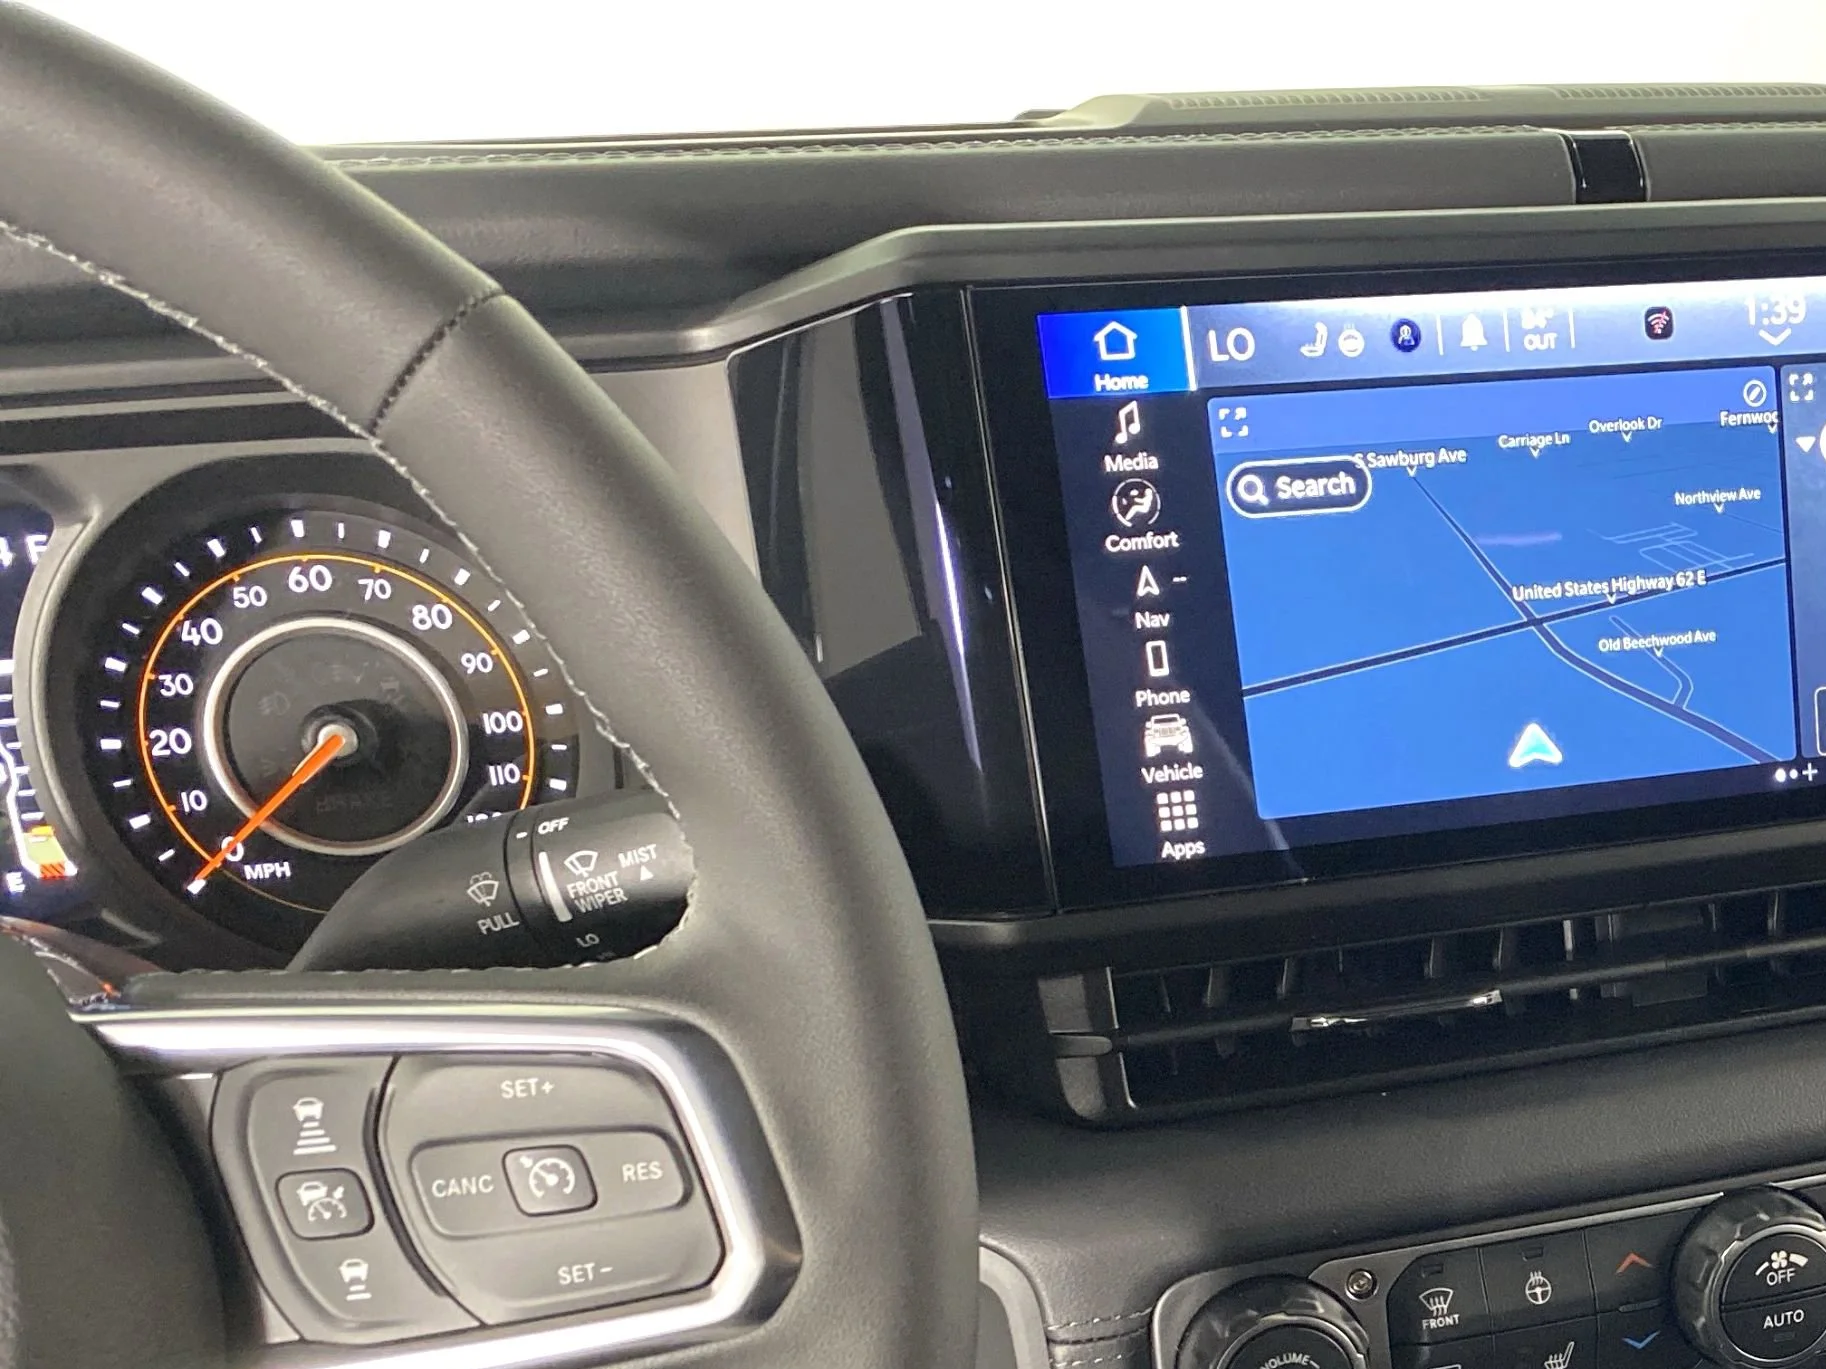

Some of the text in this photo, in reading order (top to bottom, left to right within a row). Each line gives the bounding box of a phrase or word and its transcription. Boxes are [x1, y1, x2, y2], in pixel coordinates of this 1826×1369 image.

[1744, 294, 1806, 326] 1:39
[1209, 328, 1255, 363] LO
[1523, 332, 1558, 352] OUT
[1094, 373, 1149, 392] Home
[1589, 416, 1663, 434] Overlook Dr
[1498, 431, 1570, 450] Carriage Ln
[1105, 452, 1159, 472] Media
[1367, 449, 1435, 469] Sawburg
[1438, 447, 1468, 463] Ave
[1277, 472, 1356, 500] Search
[1674, 486, 1762, 506] Northview Ave
[25, 534, 49, 566] F
[1105, 531, 1180, 551] Comfort
[287, 565, 333, 595] 60
[358, 577, 392, 602] 70
[1512, 570, 1707, 603] United States Highway 62 E
[232, 584, 268, 609] 50
[412, 603, 453, 631] 80
[1135, 610, 1170, 630] Nav
[180, 618, 224, 647] 40
[1599, 628, 1717, 652] Old Beechwood Ave
[461, 652, 494, 676] 90
[159, 673, 194, 698] 30
[1135, 687, 1191, 707] Phone
[483, 712, 523, 735] 100
[149, 729, 192, 756] 20
[488, 764, 521, 787] 110
[1141, 761, 1203, 783] Vehicle
[181, 790, 208, 814] 10
[537, 817, 570, 835] OFF
[618, 844, 657, 868] MIST
[1161, 838, 1206, 862] Apps
[7, 871, 26, 894] E
[244, 862, 291, 882] MPH
[566, 871, 619, 898] FRONT
[574, 888, 628, 914] WIPER
[477, 912, 520, 935] PULL
[576, 933, 600, 949] LO
[622, 1162, 664, 1183] RES
[431, 1174, 495, 1198] CANC
[1765, 1267, 1796, 1286] OFF
[1421, 1313, 1461, 1330] FRONT
[1762, 1309, 1804, 1329] AUTO
